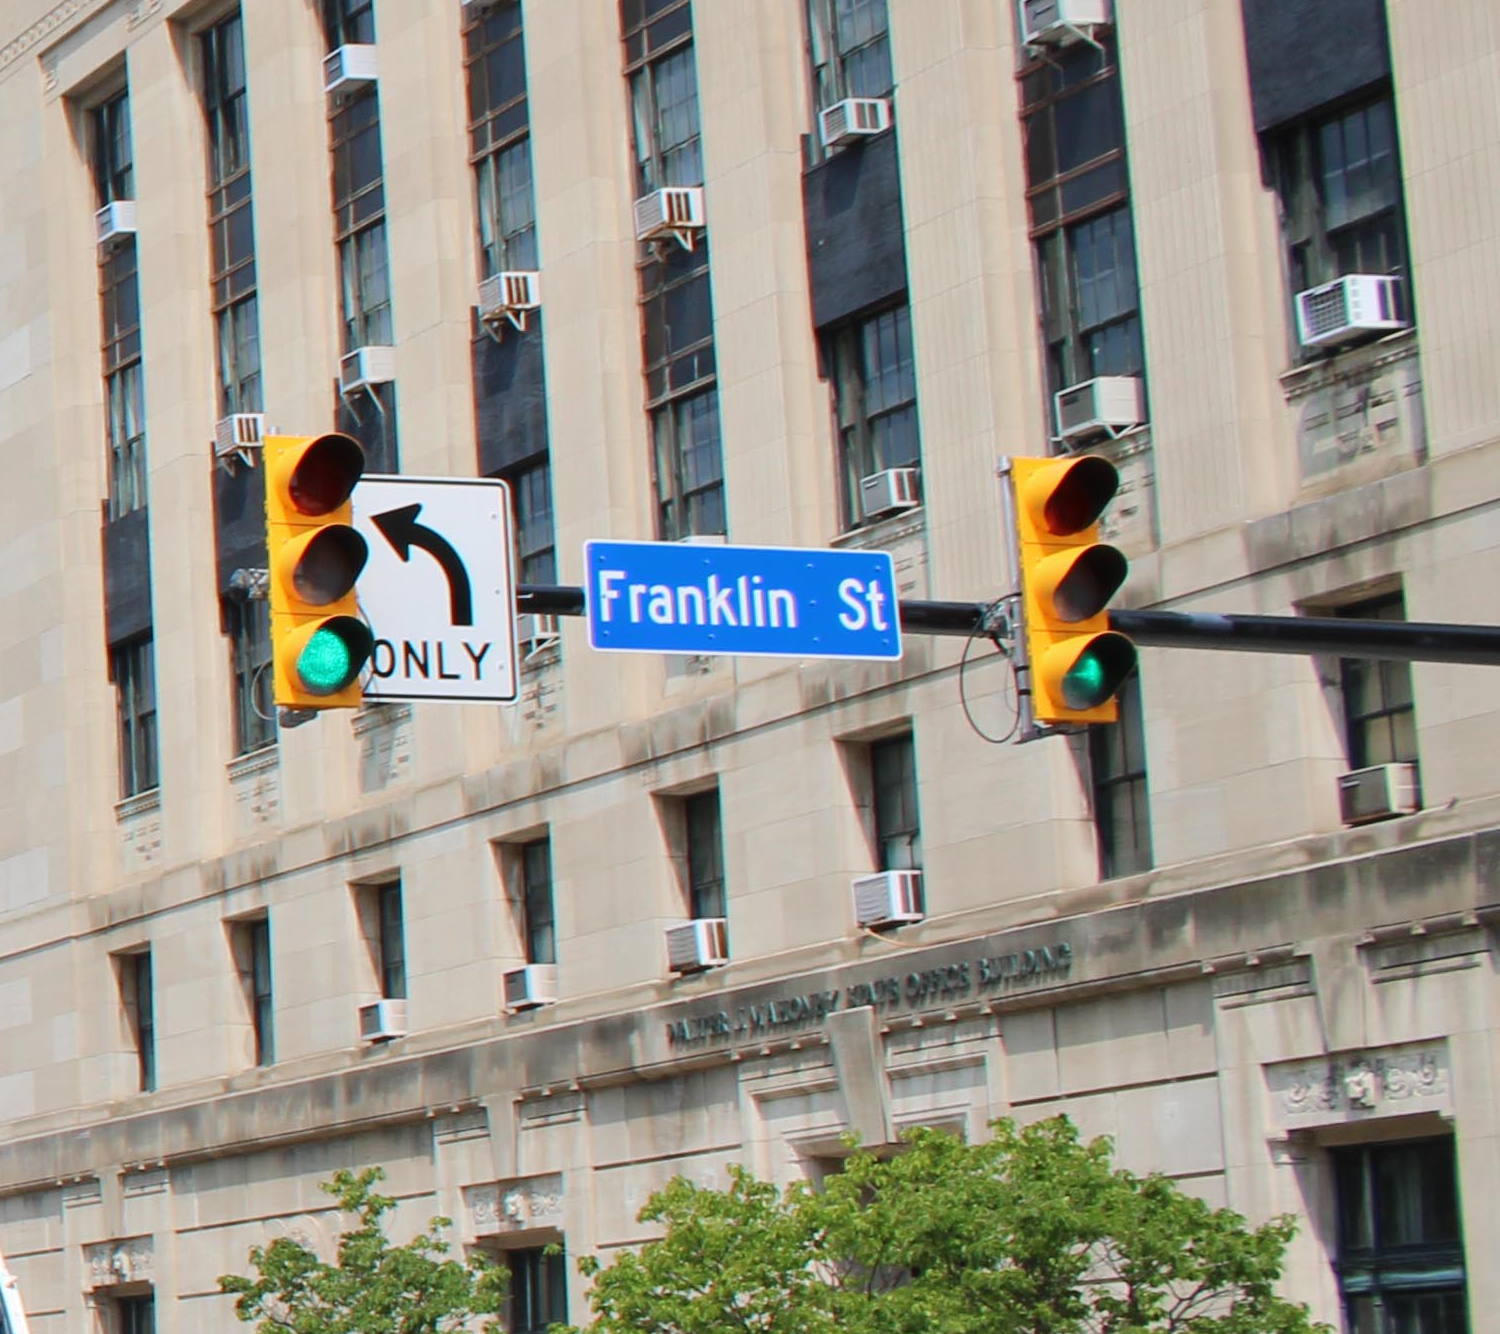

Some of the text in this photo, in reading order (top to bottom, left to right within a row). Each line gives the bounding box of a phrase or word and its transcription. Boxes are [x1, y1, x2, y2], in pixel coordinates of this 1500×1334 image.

[599, 569, 889, 632] Franklin St
[370, 638, 492, 680] ONLY
[978, 941, 1072, 984] BUILDING
